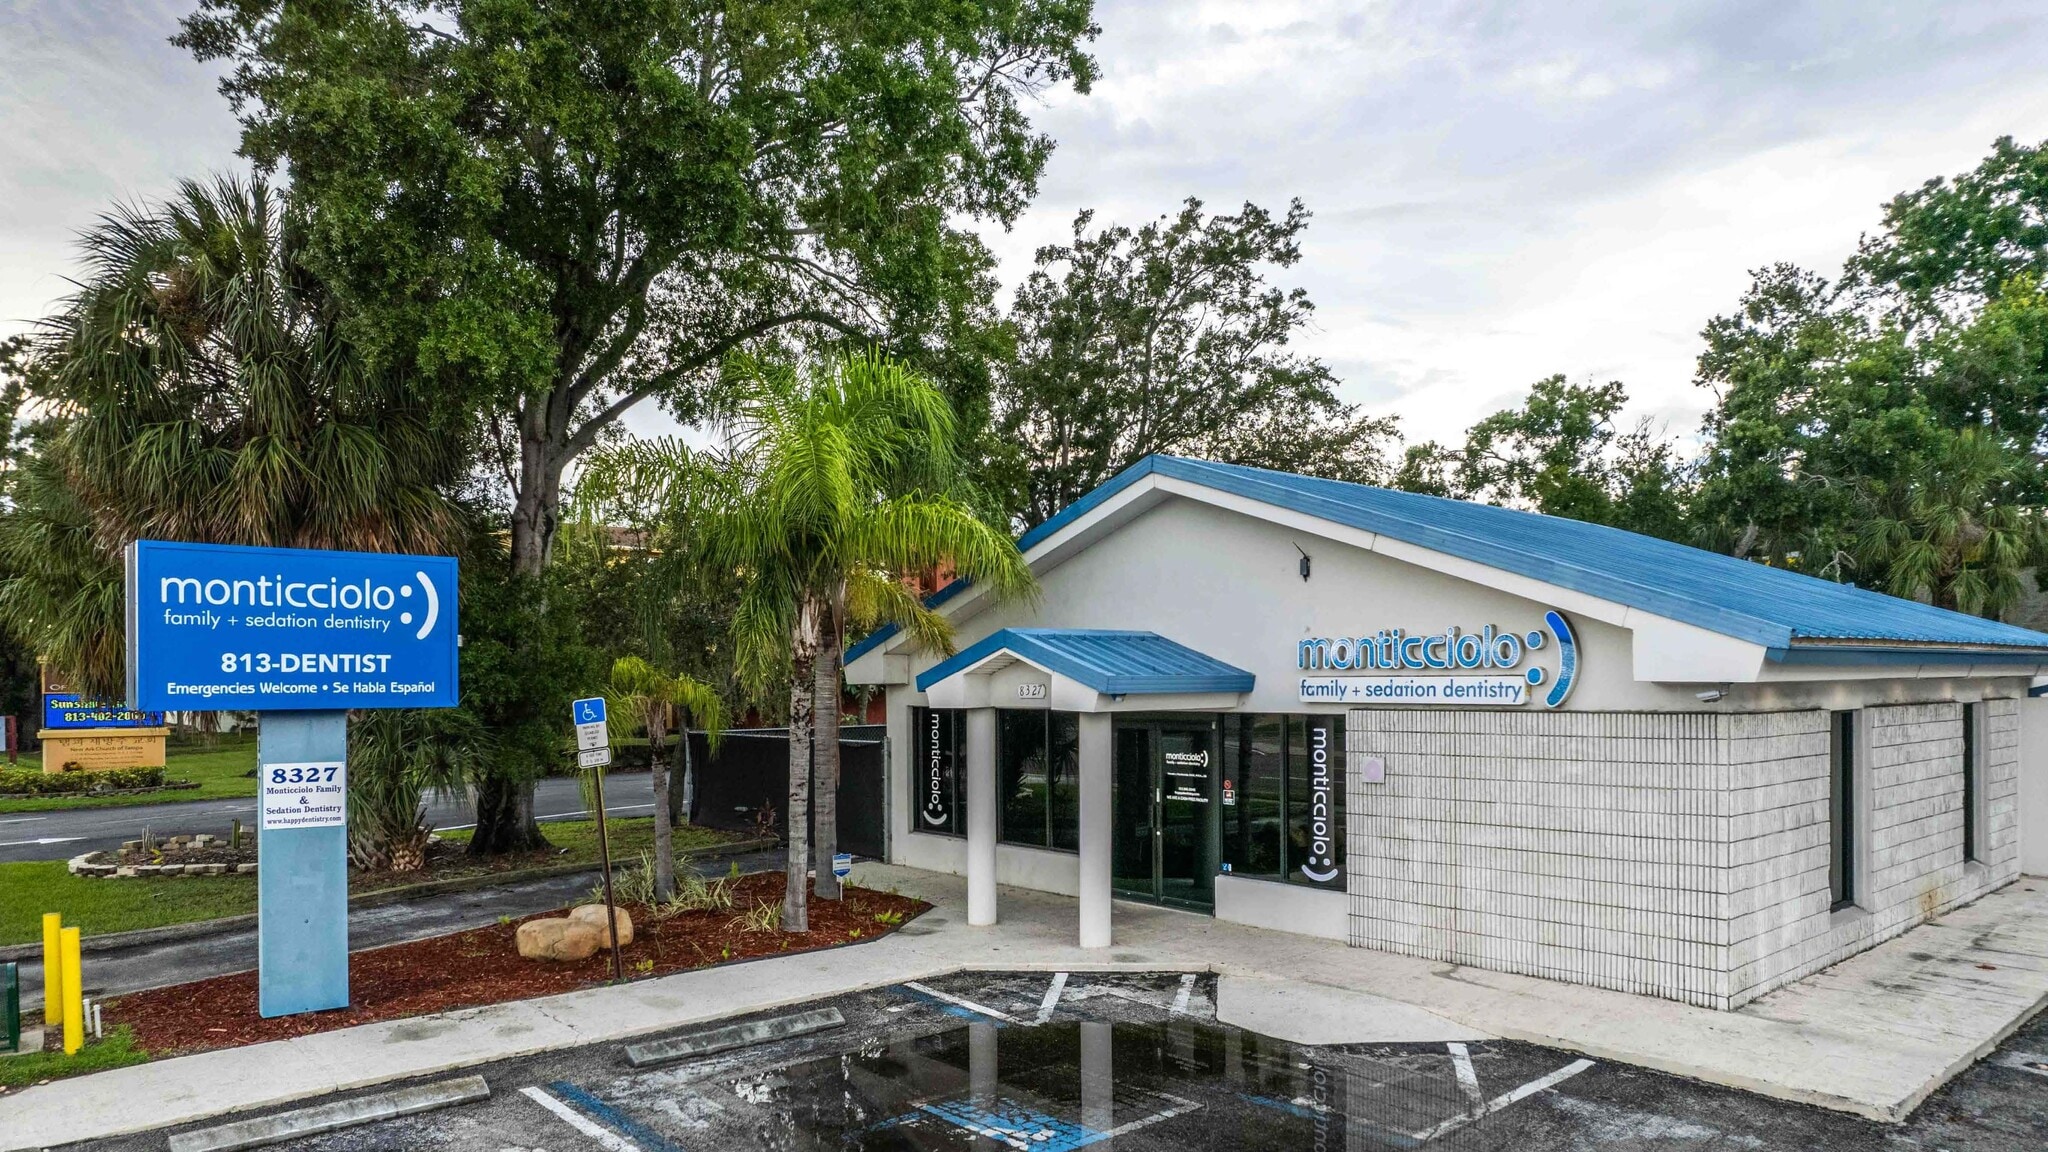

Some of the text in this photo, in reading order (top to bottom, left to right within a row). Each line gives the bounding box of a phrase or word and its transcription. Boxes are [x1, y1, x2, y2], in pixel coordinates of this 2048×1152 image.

[164, 608, 221, 629] family
[246, 611, 317, 628] sedation
[324, 615, 390, 632] dentistry
[221, 653, 391, 673] 813-DENTIST
[167, 680, 435, 697] Emergencies Welcome Se Habla Español
[1020, 685, 1042, 697] 8327
[1301, 679, 1347, 701] family
[1365, 679, 1436, 698] sedation
[1443, 679, 1522, 702] dentistry
[272, 767, 338, 784] 8327
[266, 785, 342, 795] Monticciolo Family
[299, 796, 309, 805] &
[266, 805, 342, 815] Sedation Dentistry
